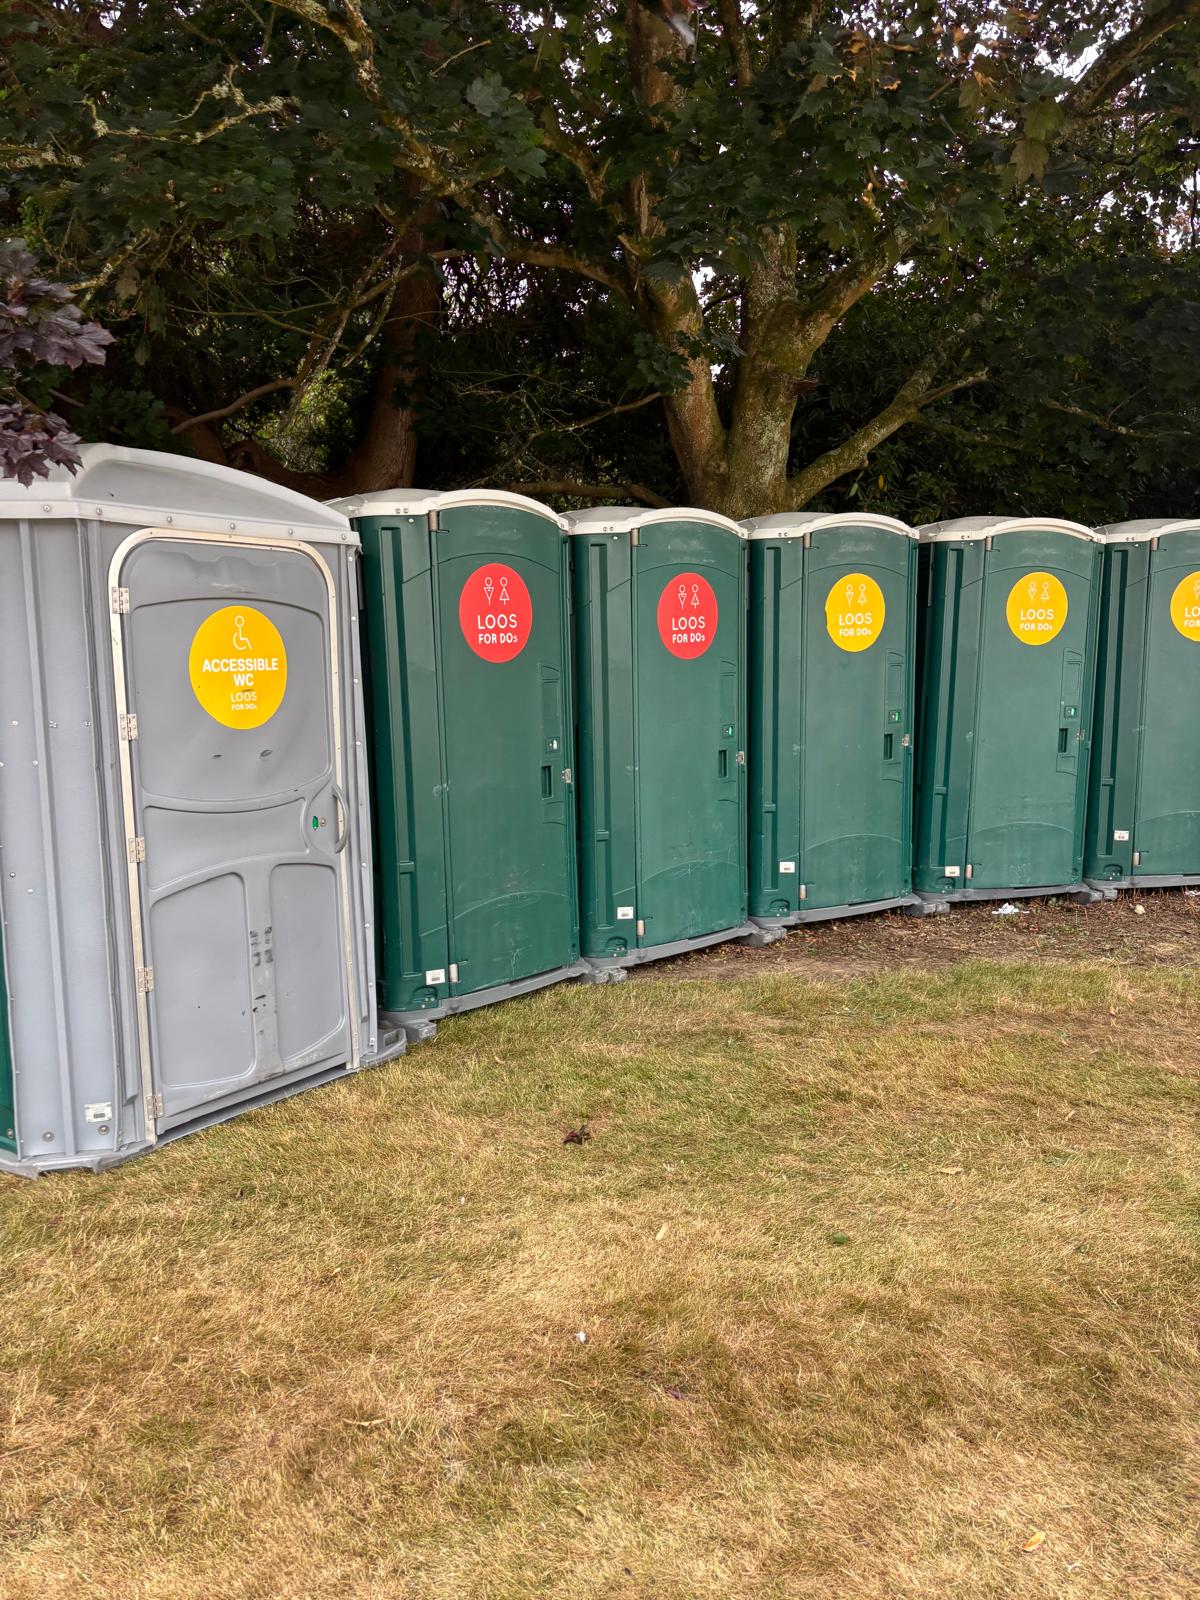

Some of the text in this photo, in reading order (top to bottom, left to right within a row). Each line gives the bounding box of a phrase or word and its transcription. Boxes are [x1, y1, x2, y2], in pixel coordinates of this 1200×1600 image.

[838, 612, 872, 626] LOOS
[1020, 608, 1054, 620] LOOS
[477, 613, 518, 630] LOOS
[671, 615, 706, 631] LOOS
[1020, 622, 1036, 631] FOR
[478, 632, 518, 645] FOR DOs
[672, 632, 706, 644] FOR DOs
[839, 628, 855, 637] FOR
[202, 658, 279, 672] ACCESSIBLE
[233, 673, 254, 687] WC
[230, 691, 257, 702] LOOS
[231, 703, 244, 711] FOR
